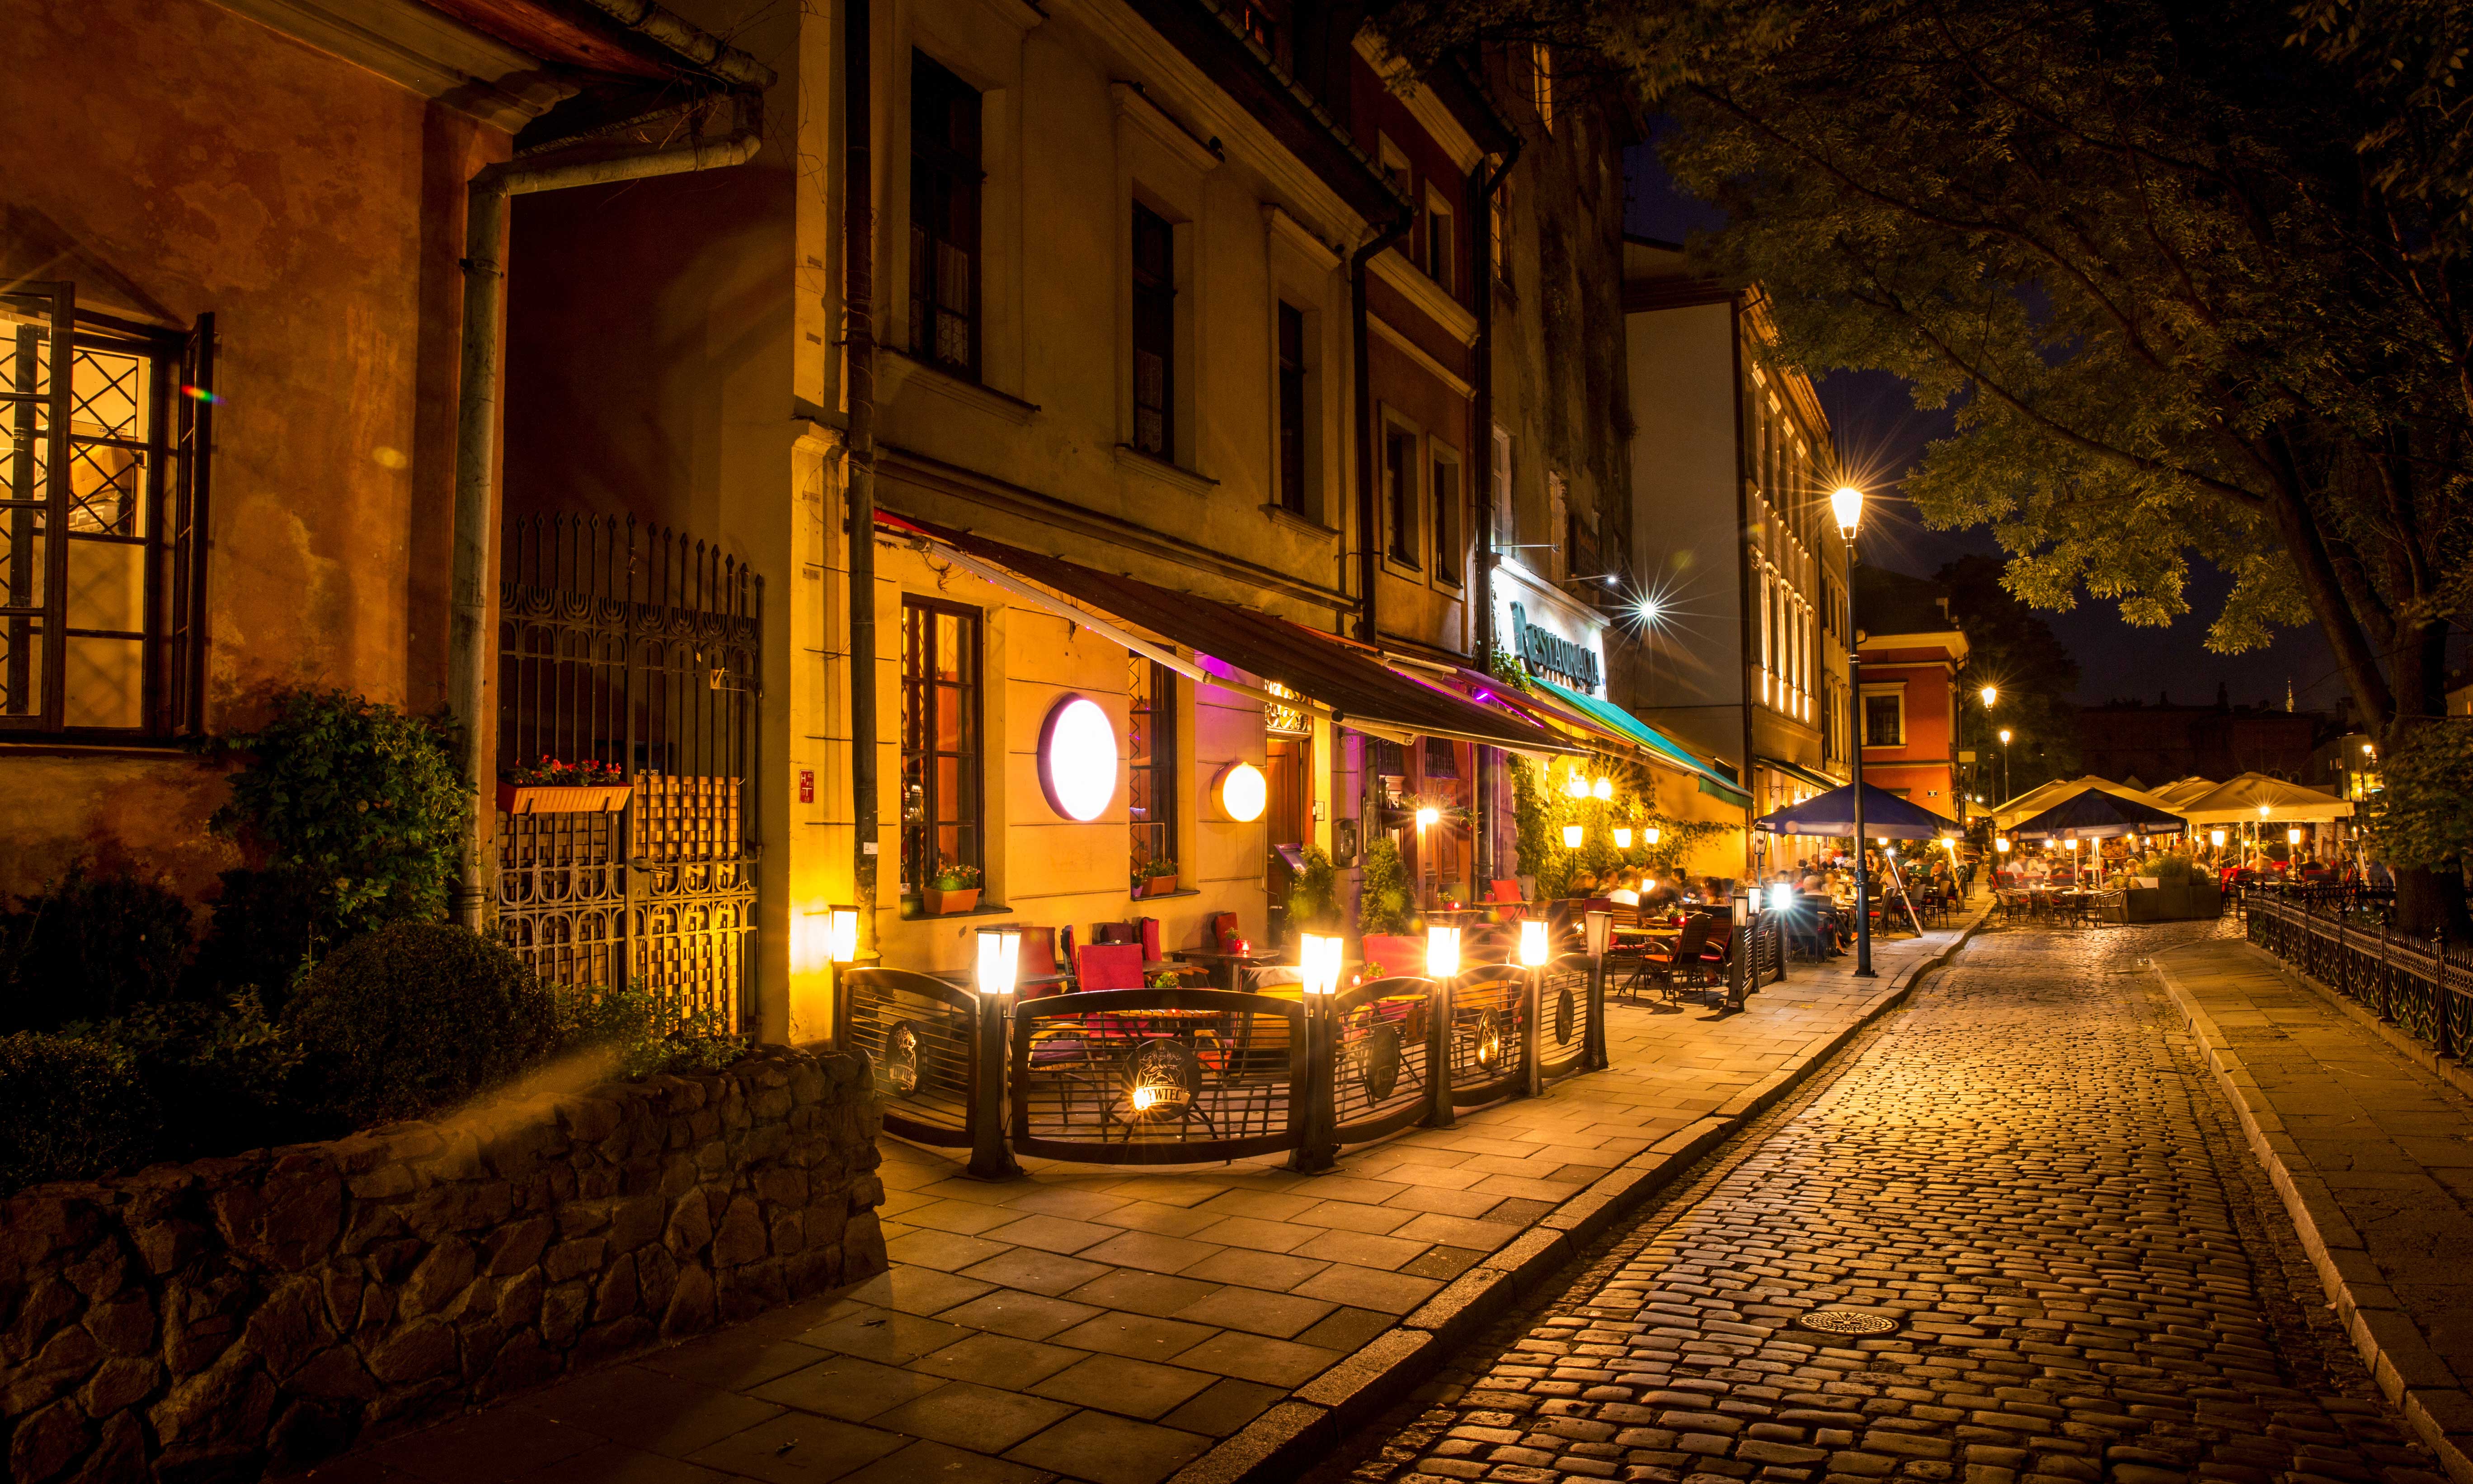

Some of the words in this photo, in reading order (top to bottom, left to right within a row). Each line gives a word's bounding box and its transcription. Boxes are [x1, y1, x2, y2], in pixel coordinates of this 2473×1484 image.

[1509, 600, 1600, 695] RESTAURACJA
[801, 773, 806, 783] H
[802, 787, 813, 796] T
[1142, 1087, 1181, 1101] YWIEC
